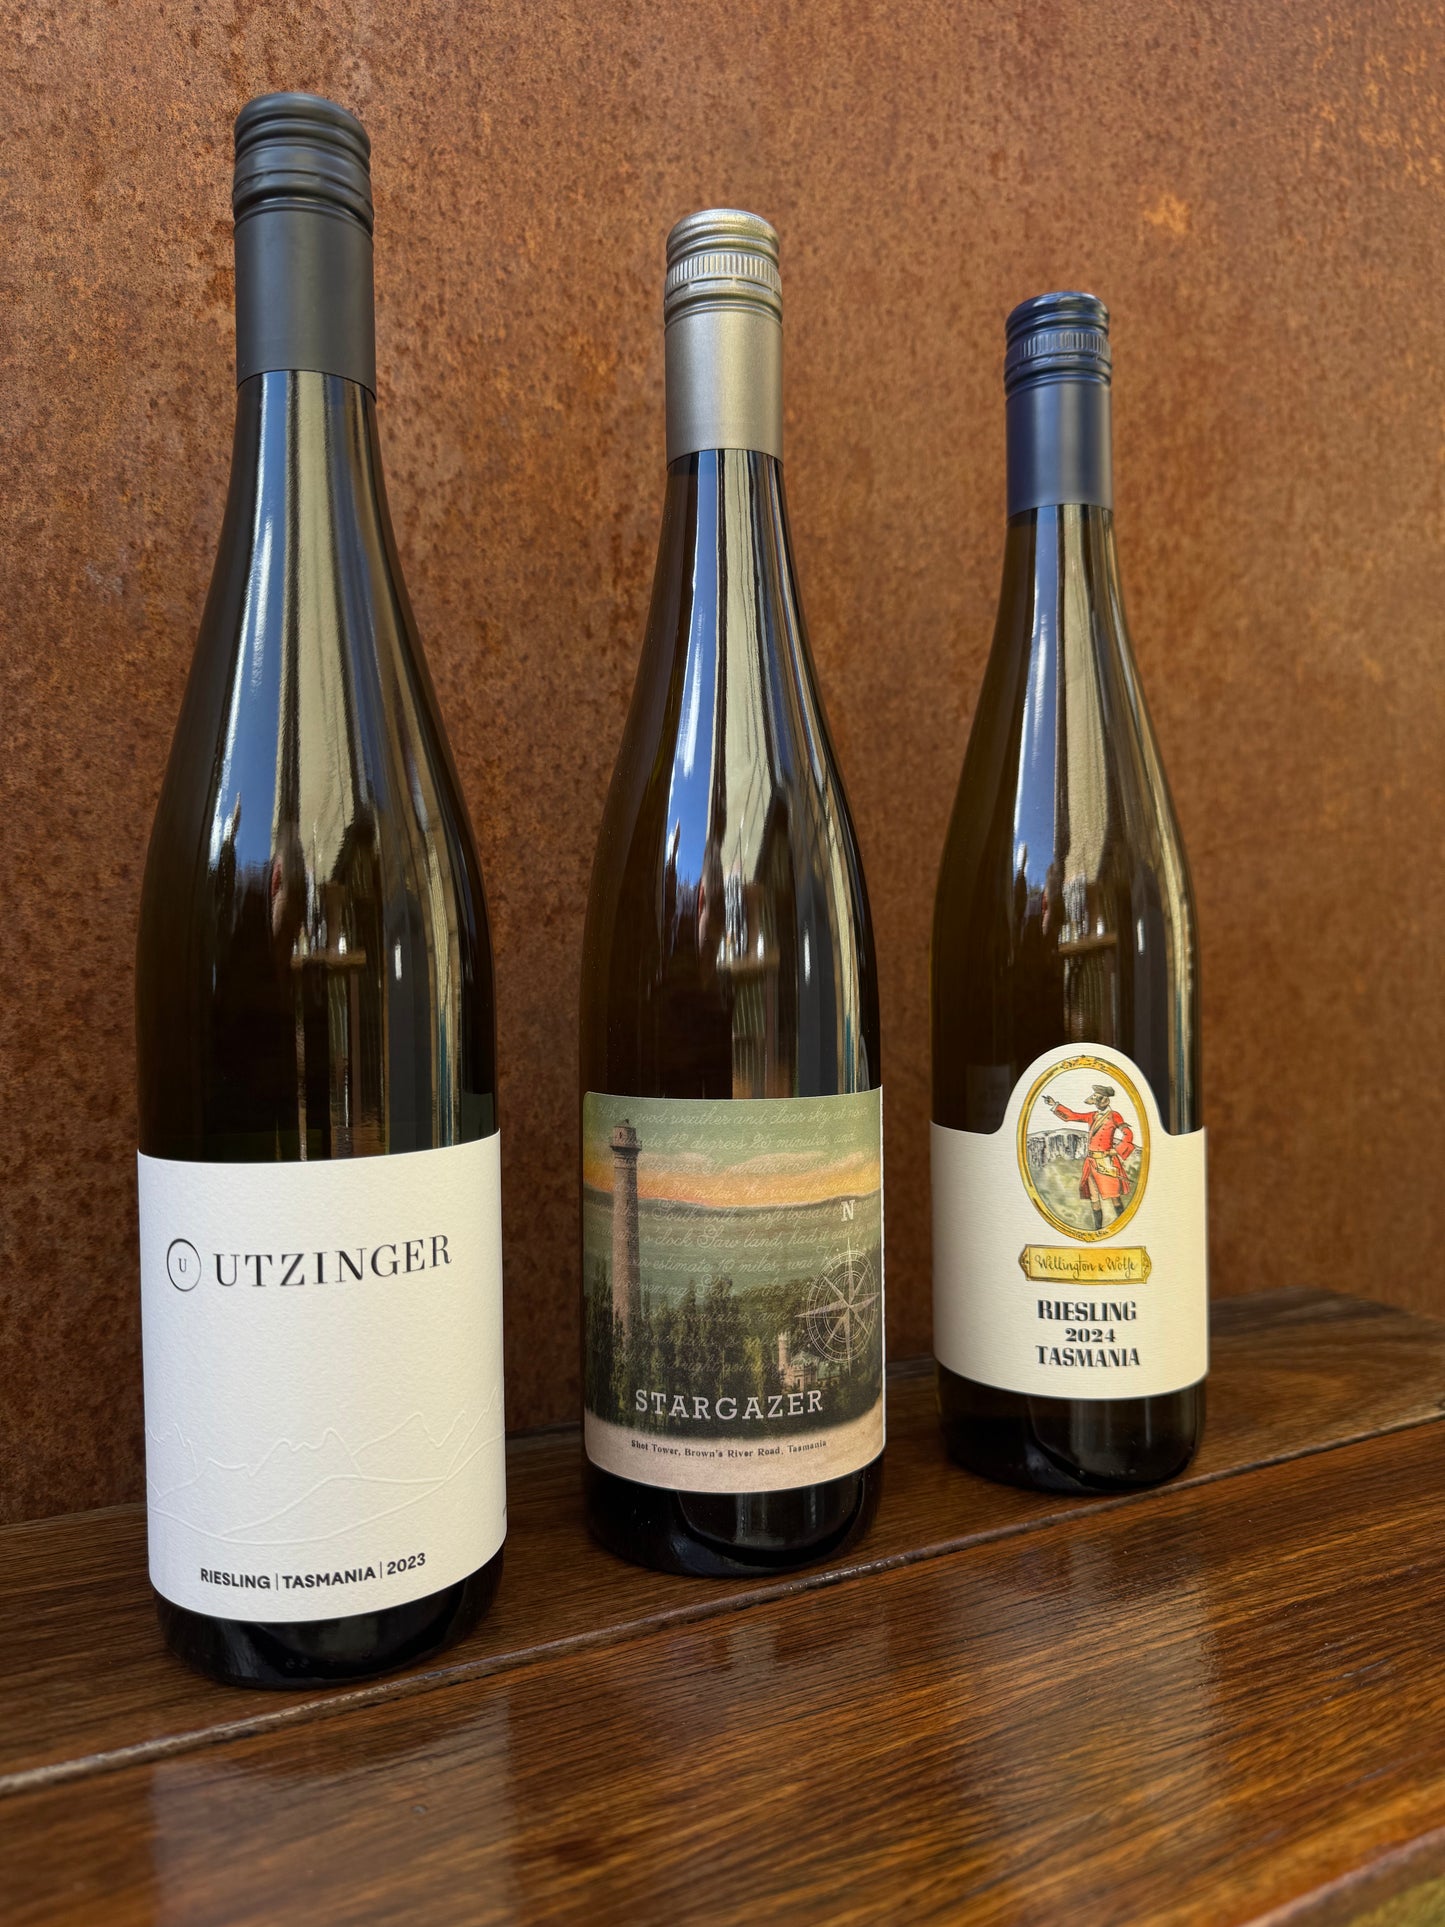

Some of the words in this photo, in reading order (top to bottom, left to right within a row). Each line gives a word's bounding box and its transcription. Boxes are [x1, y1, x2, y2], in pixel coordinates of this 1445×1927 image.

[674, 1105, 731, 1125] weather
[734, 1108, 768, 1125] and
[807, 1103, 832, 1129] sky
[690, 1135, 747, 1158] degrees
[841, 1200, 855, 1221] N
[787, 1226, 818, 1245] had
[178, 1258, 187, 1273] U
[214, 1234, 453, 1287] UTZINGER
[653, 1255, 713, 1273] estimate
[1035, 1254, 1096, 1280] Wellington
[1105, 1256, 1136, 1278] Wolfe
[1037, 1299, 1137, 1321] RIESLING
[1065, 1327, 1114, 1343] 2024
[1035, 1345, 1140, 1367] TASMANIA
[635, 1388, 823, 1421] STARGAZER
[631, 1439, 649, 1451] Shot
[651, 1443, 682, 1457] Tower,
[684, 1448, 723, 1458] Brown's
[727, 1449, 754, 1458] River
[757, 1446, 784, 1456] Road,
[787, 1439, 827, 1453] Tasmania
[200, 1567, 271, 1590] RIESLING
[282, 1566, 376, 1590] TASMANIA
[386, 1552, 427, 1576] 2023
